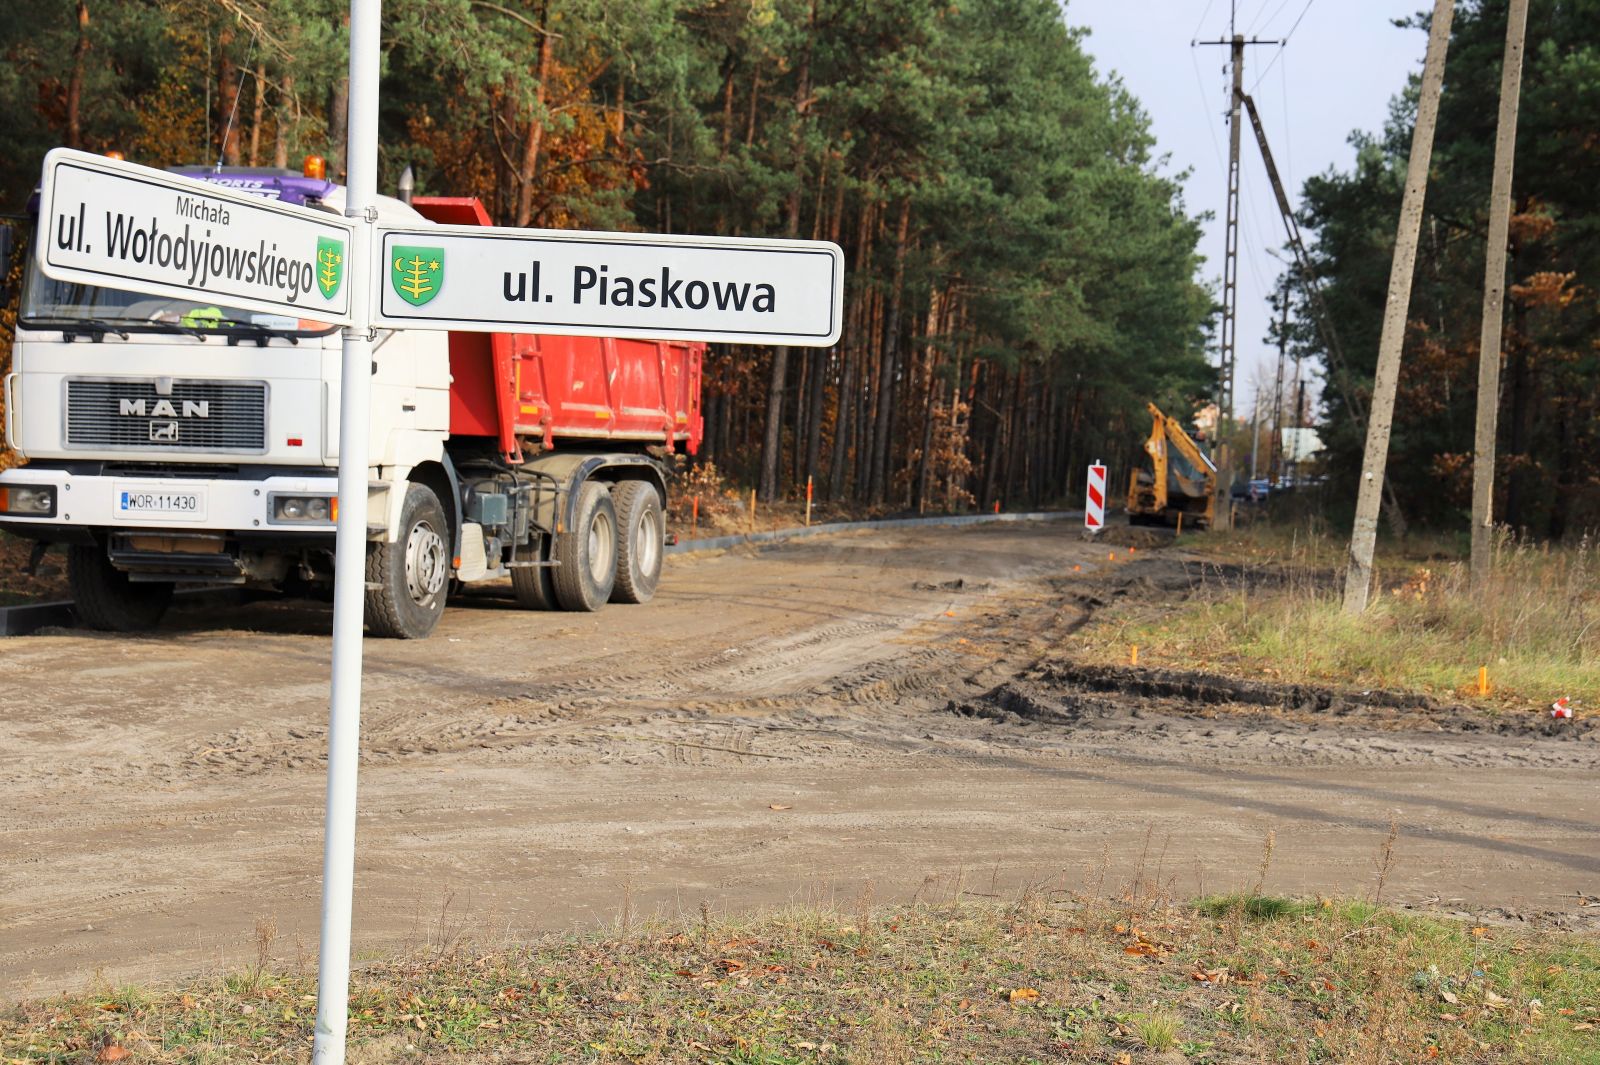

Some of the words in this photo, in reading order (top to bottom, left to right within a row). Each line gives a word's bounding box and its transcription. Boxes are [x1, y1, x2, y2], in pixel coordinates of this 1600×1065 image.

[175, 195, 231, 226] Michała
[57, 202, 91, 254] ul.
[106, 210, 313, 303] Wołodyjowskiego
[503, 260, 553, 303] ul.
[573, 265, 776, 313] Piaskowa
[119, 399, 209, 418] MAN
[129, 494, 153, 508] WOR
[159, 495, 196, 510] 11430
